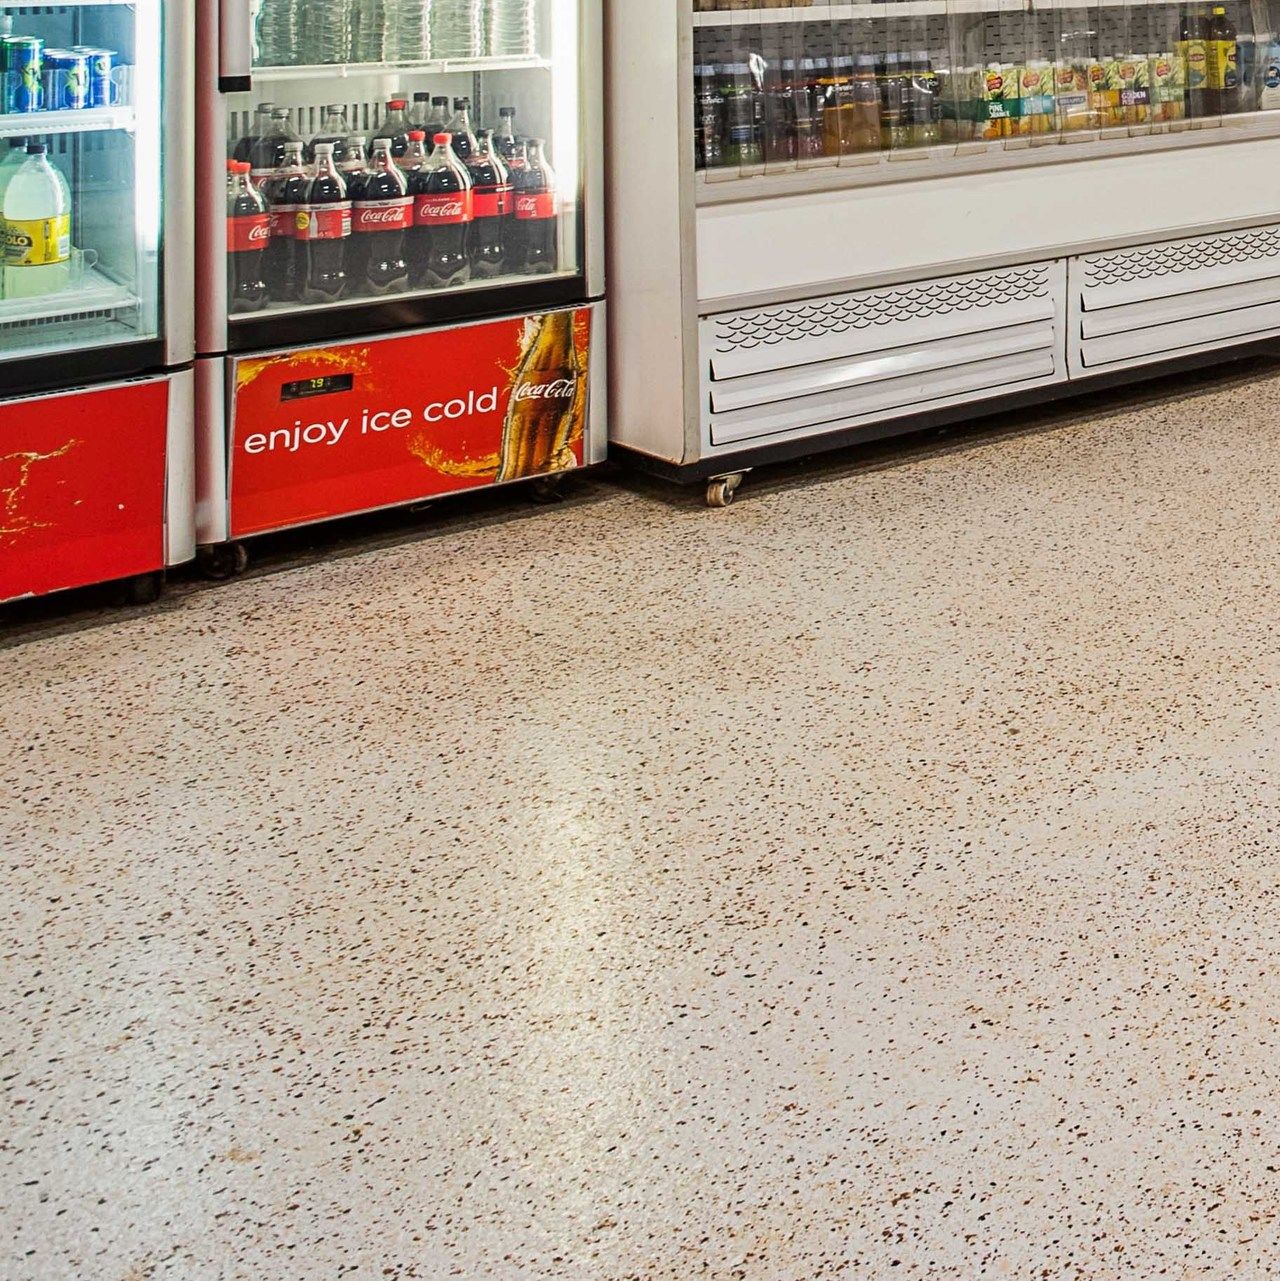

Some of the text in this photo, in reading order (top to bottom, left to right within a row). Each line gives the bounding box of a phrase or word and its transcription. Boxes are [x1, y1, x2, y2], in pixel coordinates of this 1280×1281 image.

[243, 386, 498, 455] enjoy ice cold
